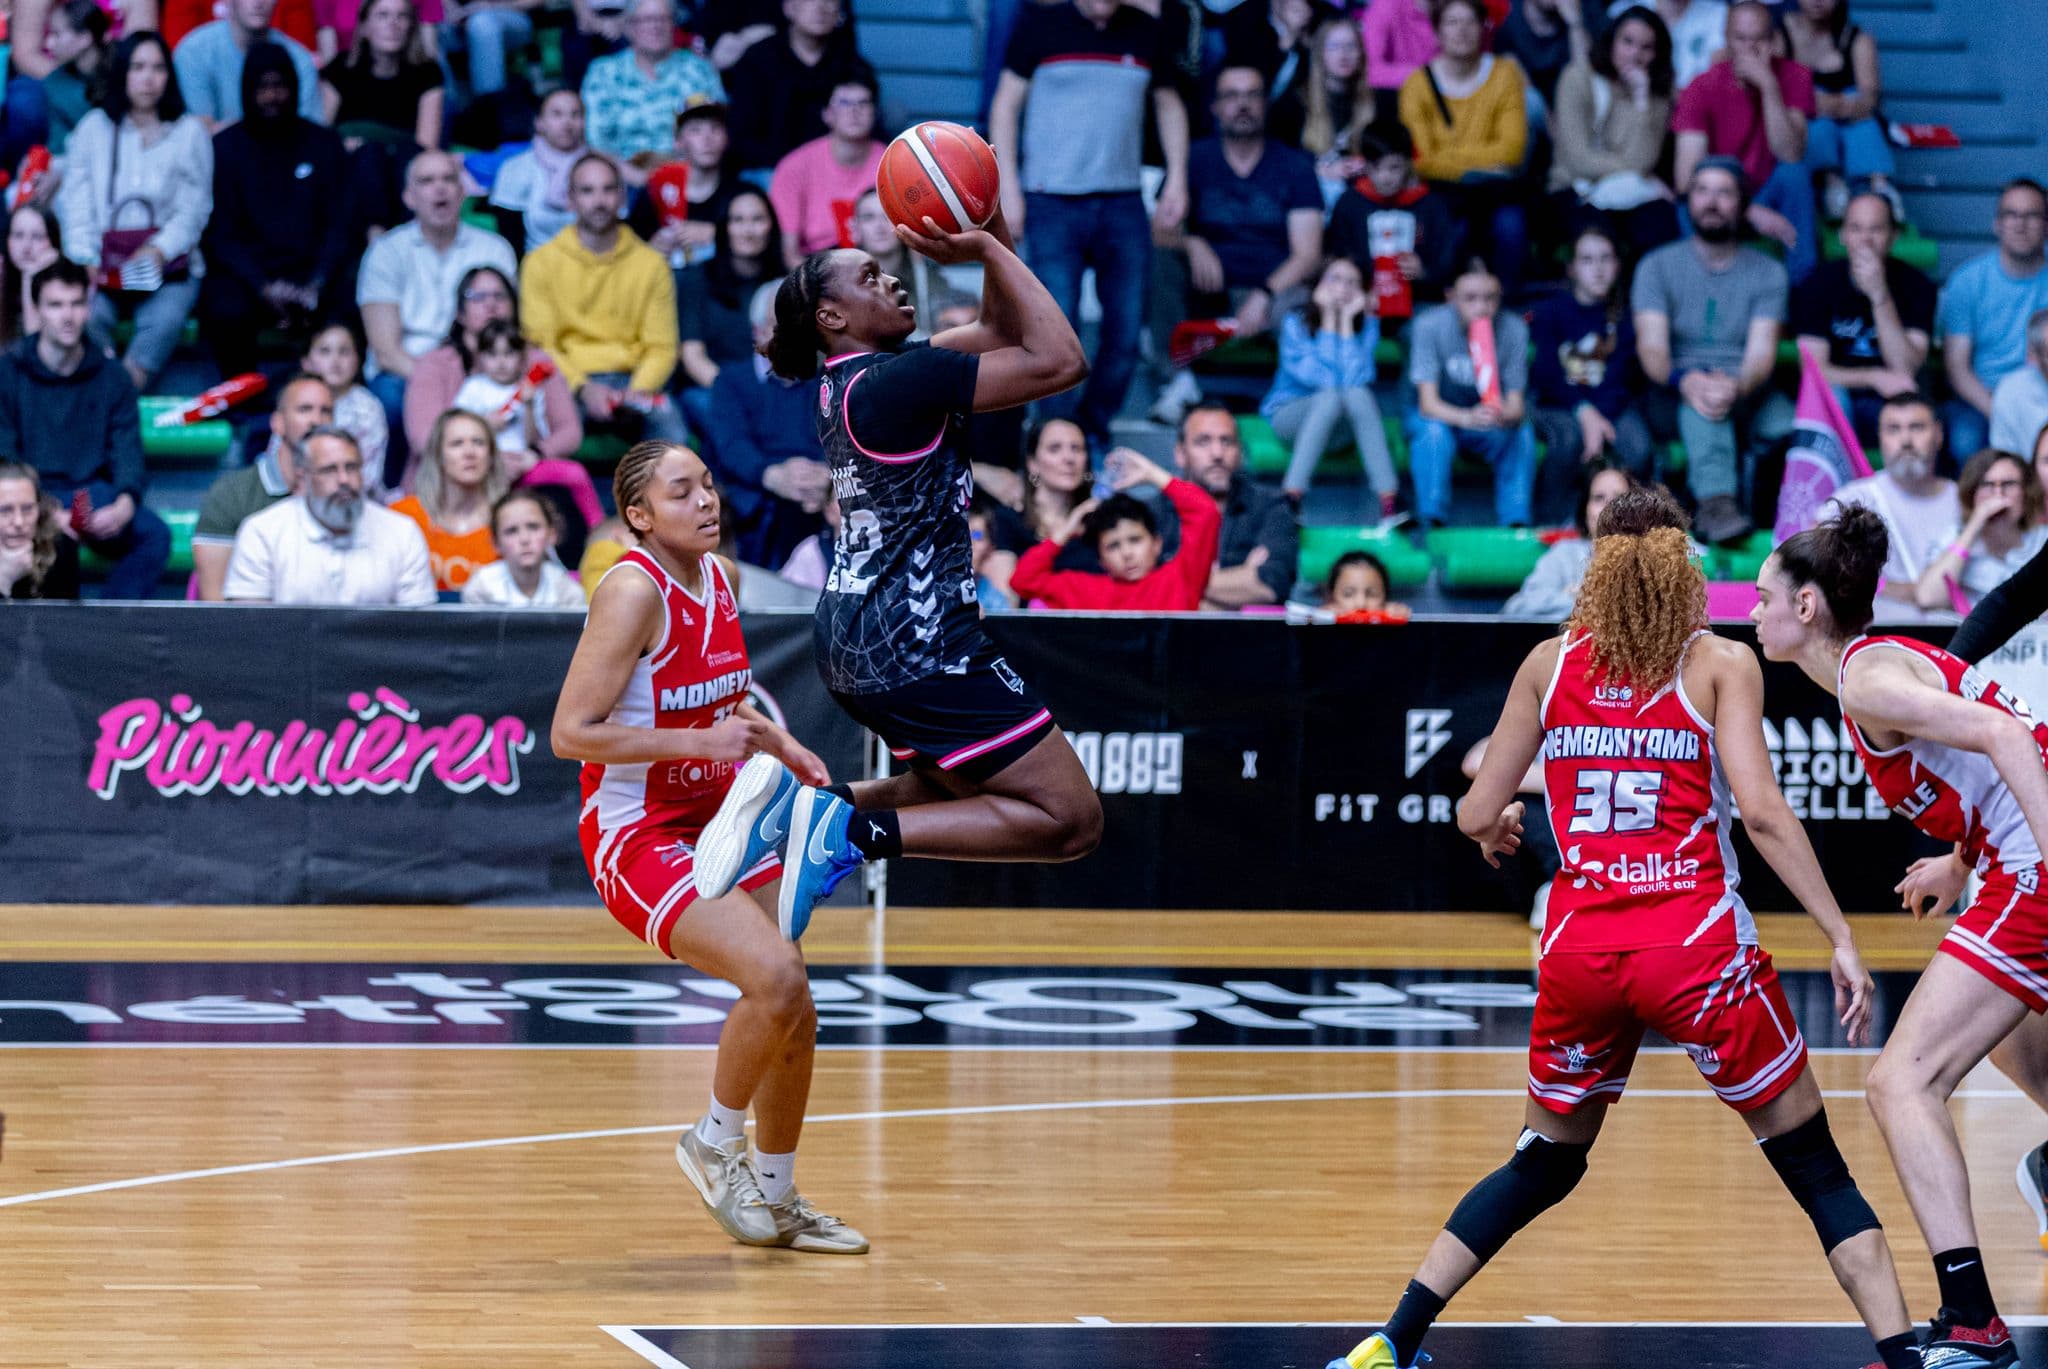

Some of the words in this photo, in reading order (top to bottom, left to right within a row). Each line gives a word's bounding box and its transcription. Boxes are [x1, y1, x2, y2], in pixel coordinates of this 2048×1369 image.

[87, 686, 536, 800] Pionnières
[1063, 730, 1185, 796] 0882
[1397, 793, 1463, 824] GR
[1568, 768, 1664, 835] 35
[1607, 852, 1701, 883] dalkia
[1629, 880, 1671, 895] GROUPE
